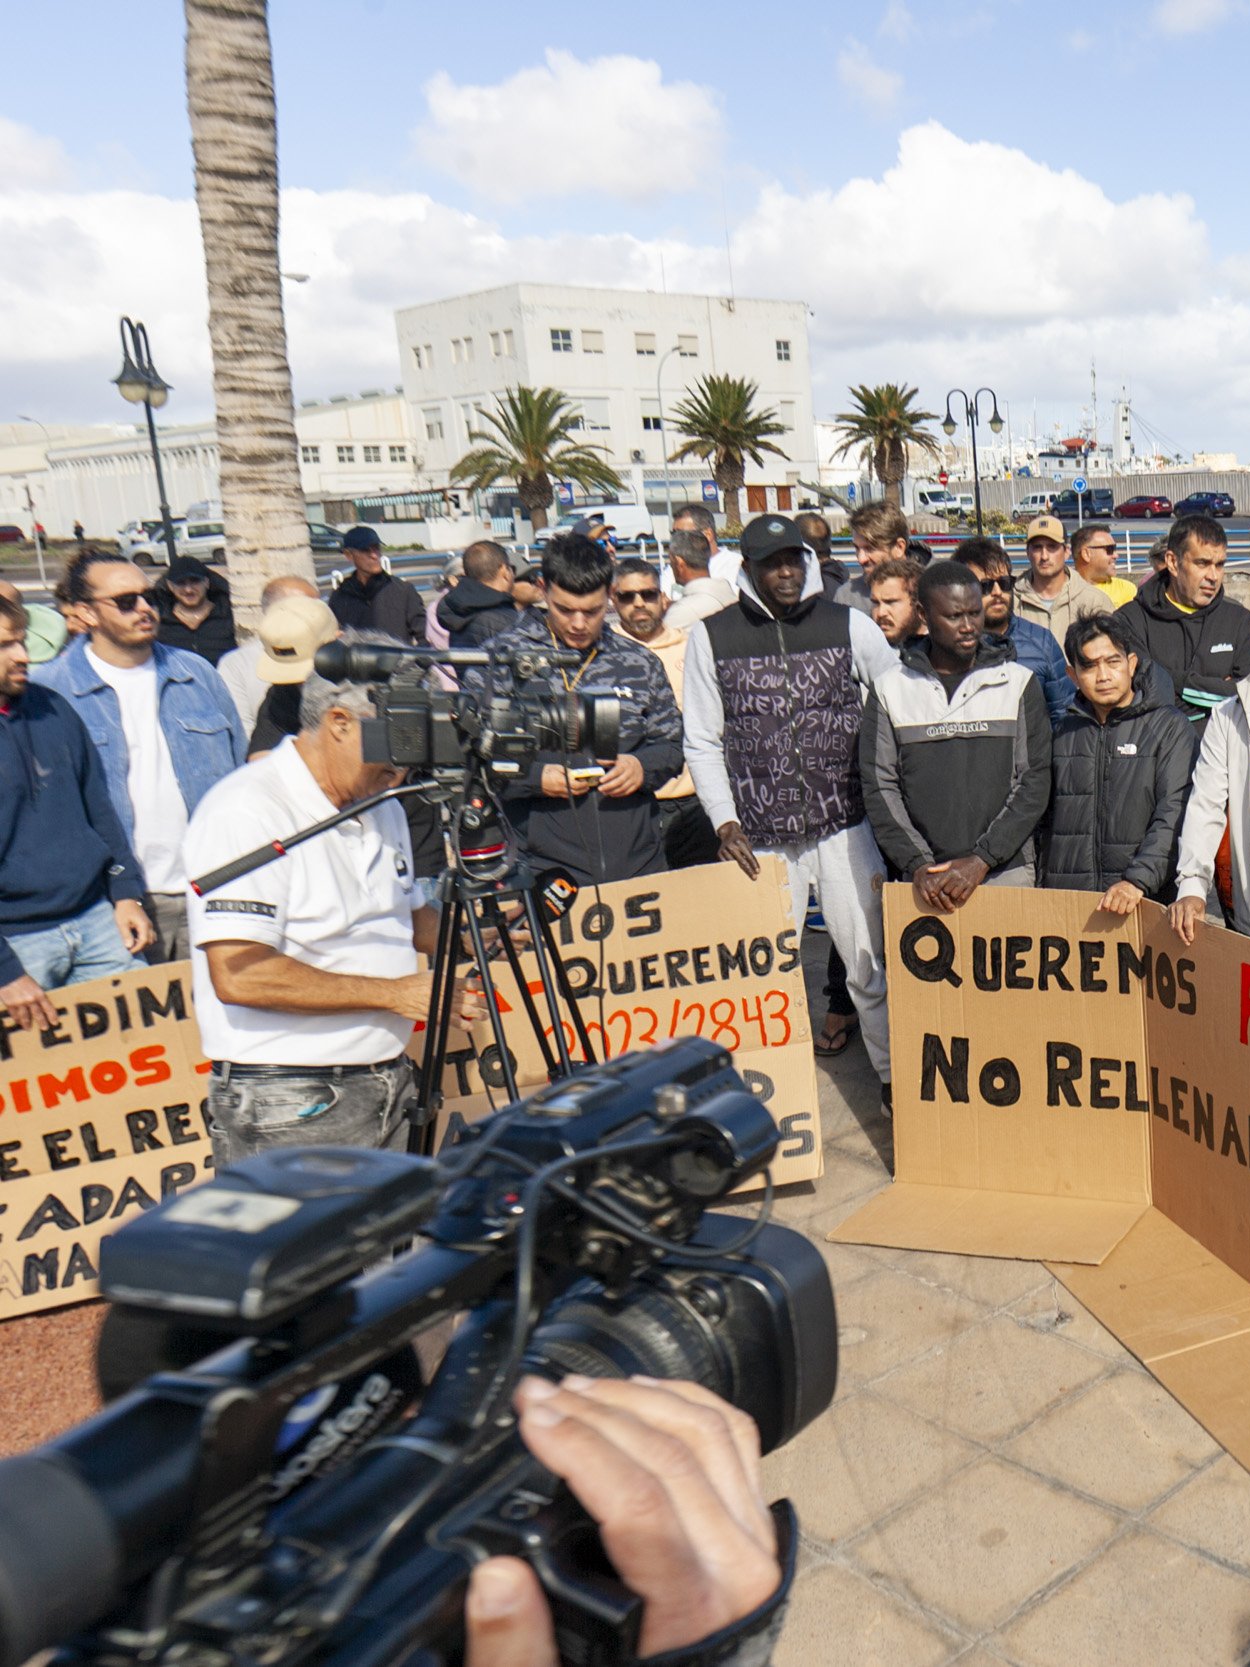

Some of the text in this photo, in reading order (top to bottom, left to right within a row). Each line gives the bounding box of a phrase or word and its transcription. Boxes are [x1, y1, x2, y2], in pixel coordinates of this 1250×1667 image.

[557, 929, 801, 999] QUEREMOS
[900, 916, 1197, 1016] QUEREMOS
[0, 979, 194, 1061] PEDIM
[42, 1121, 116, 1171] EL
[17, 1155, 216, 1242] ADAP
